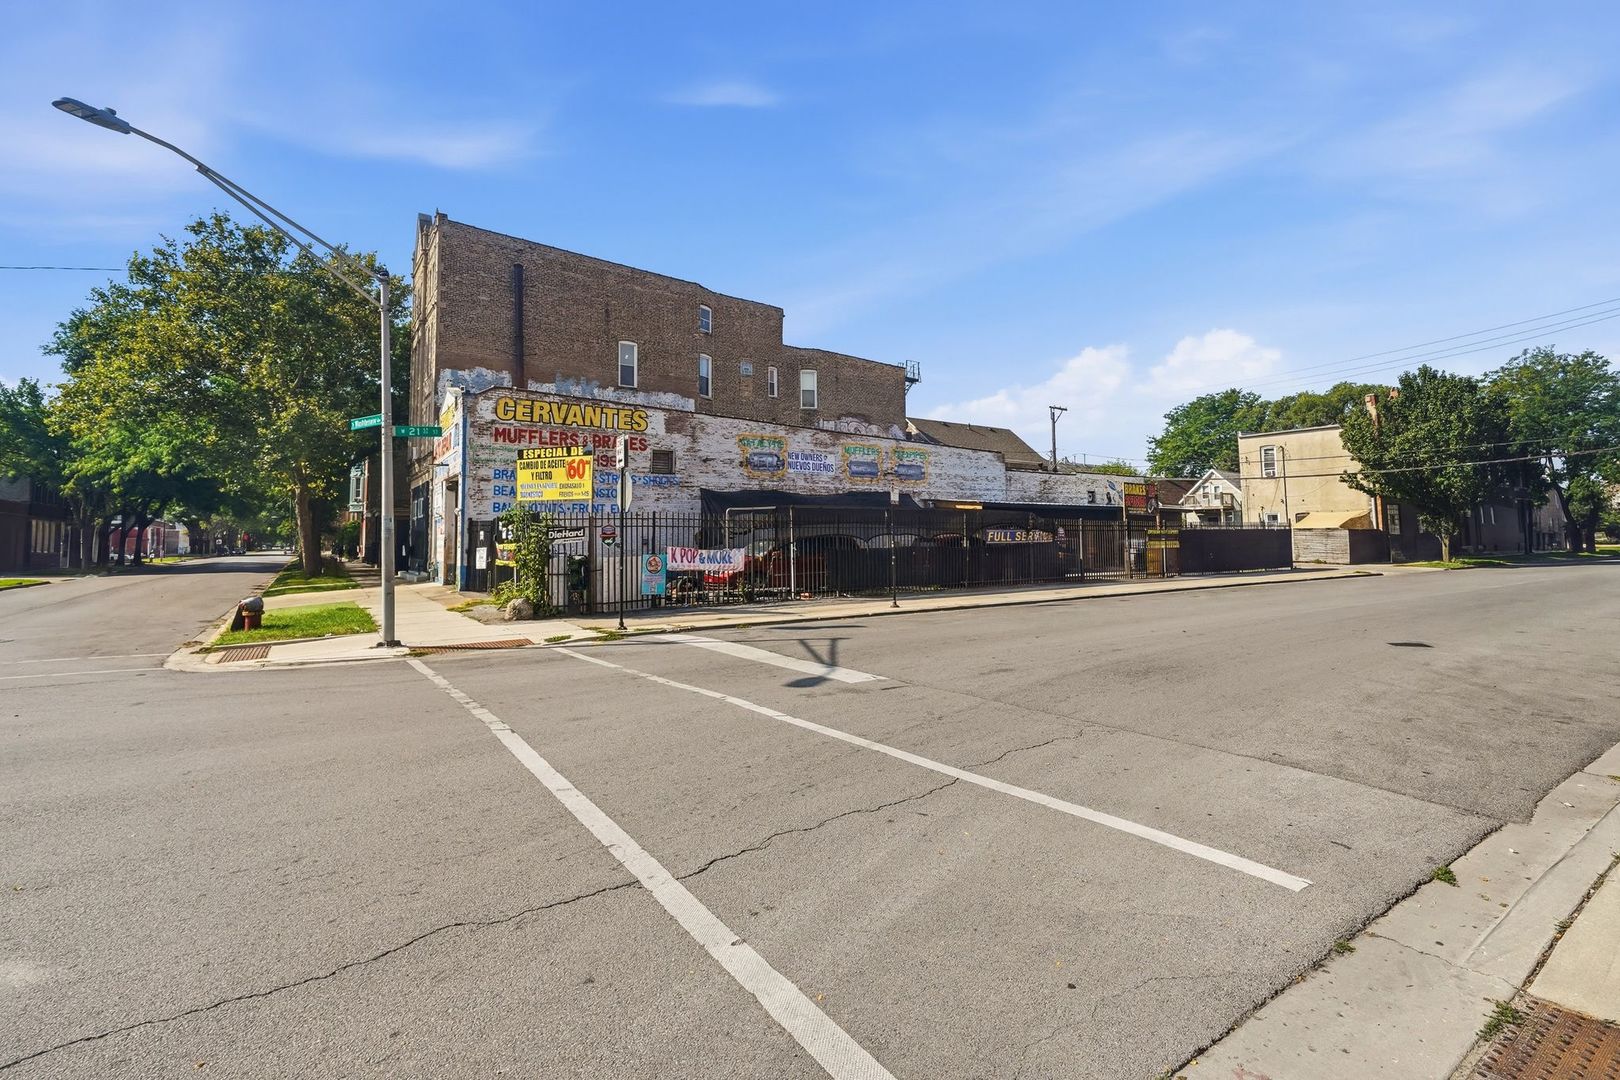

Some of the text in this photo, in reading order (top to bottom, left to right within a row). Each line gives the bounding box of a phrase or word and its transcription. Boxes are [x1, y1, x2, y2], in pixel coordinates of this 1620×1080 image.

[496, 396, 649, 432] CERVANTES
[409, 427, 420, 436] 21
[494, 426, 580, 447] MUFFLERS
[592, 433, 649, 451] BRAES
[523, 447, 568, 459] ESPECIAL
[570, 446, 584, 456] DE
[787, 451, 823, 462] NEW OWNERS
[519, 459, 566, 470] CAMBIO DE ACEITE
[787, 460, 835, 473] NUEVOS DUEÑOS
[493, 468, 517, 480] BRA
[531, 471, 553, 480] Y FILTRO
[600, 473, 638, 485] STRS
[548, 529, 584, 539] DieHard
[987, 531, 1012, 541] FULL
[671, 547, 733, 564] K POP & MORE
